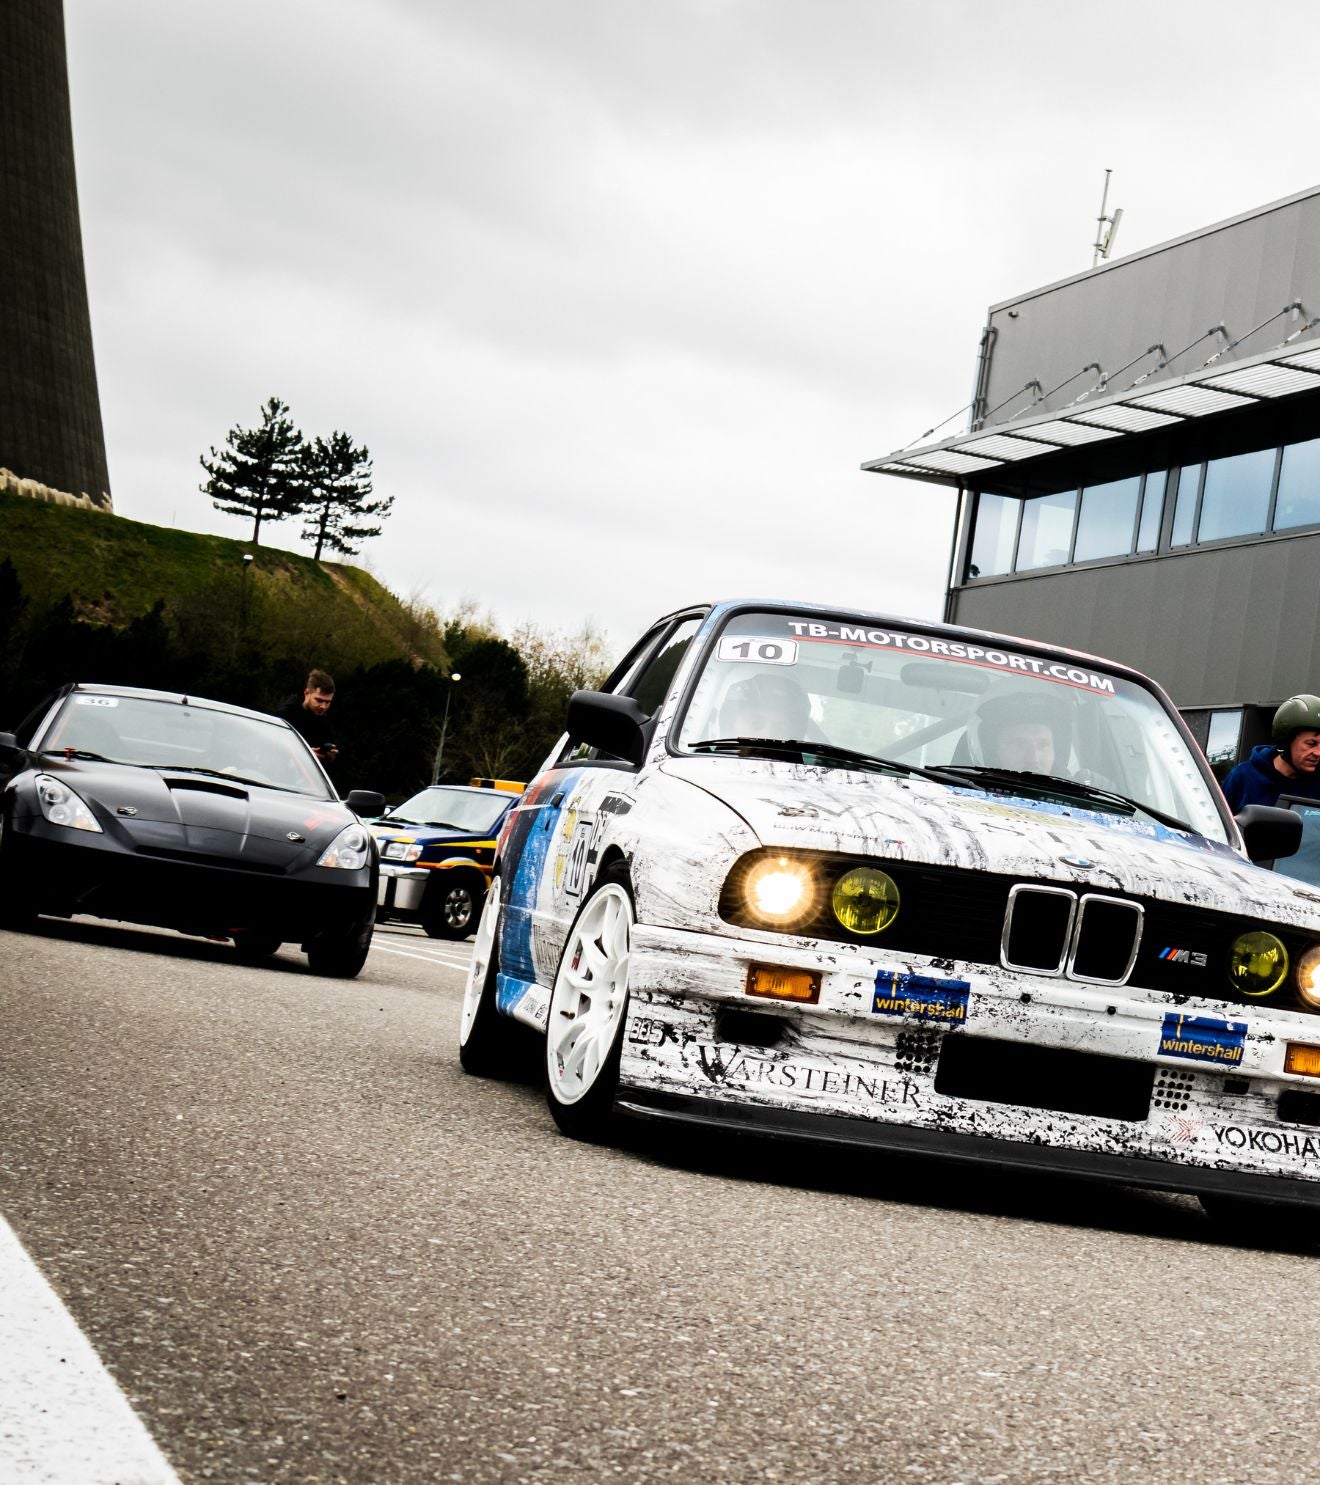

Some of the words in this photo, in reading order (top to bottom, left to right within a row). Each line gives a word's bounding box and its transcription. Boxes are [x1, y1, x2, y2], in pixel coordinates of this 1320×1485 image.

[731, 642, 783, 660] 10
[789, 621, 1116, 694] TB-MOTORSPORT.COM
[1171, 949, 1208, 967] M3
[876, 996, 965, 1019] wintershall
[1162, 1039, 1242, 1060] wintershall
[700, 1045, 922, 1109] WARSTEINER
